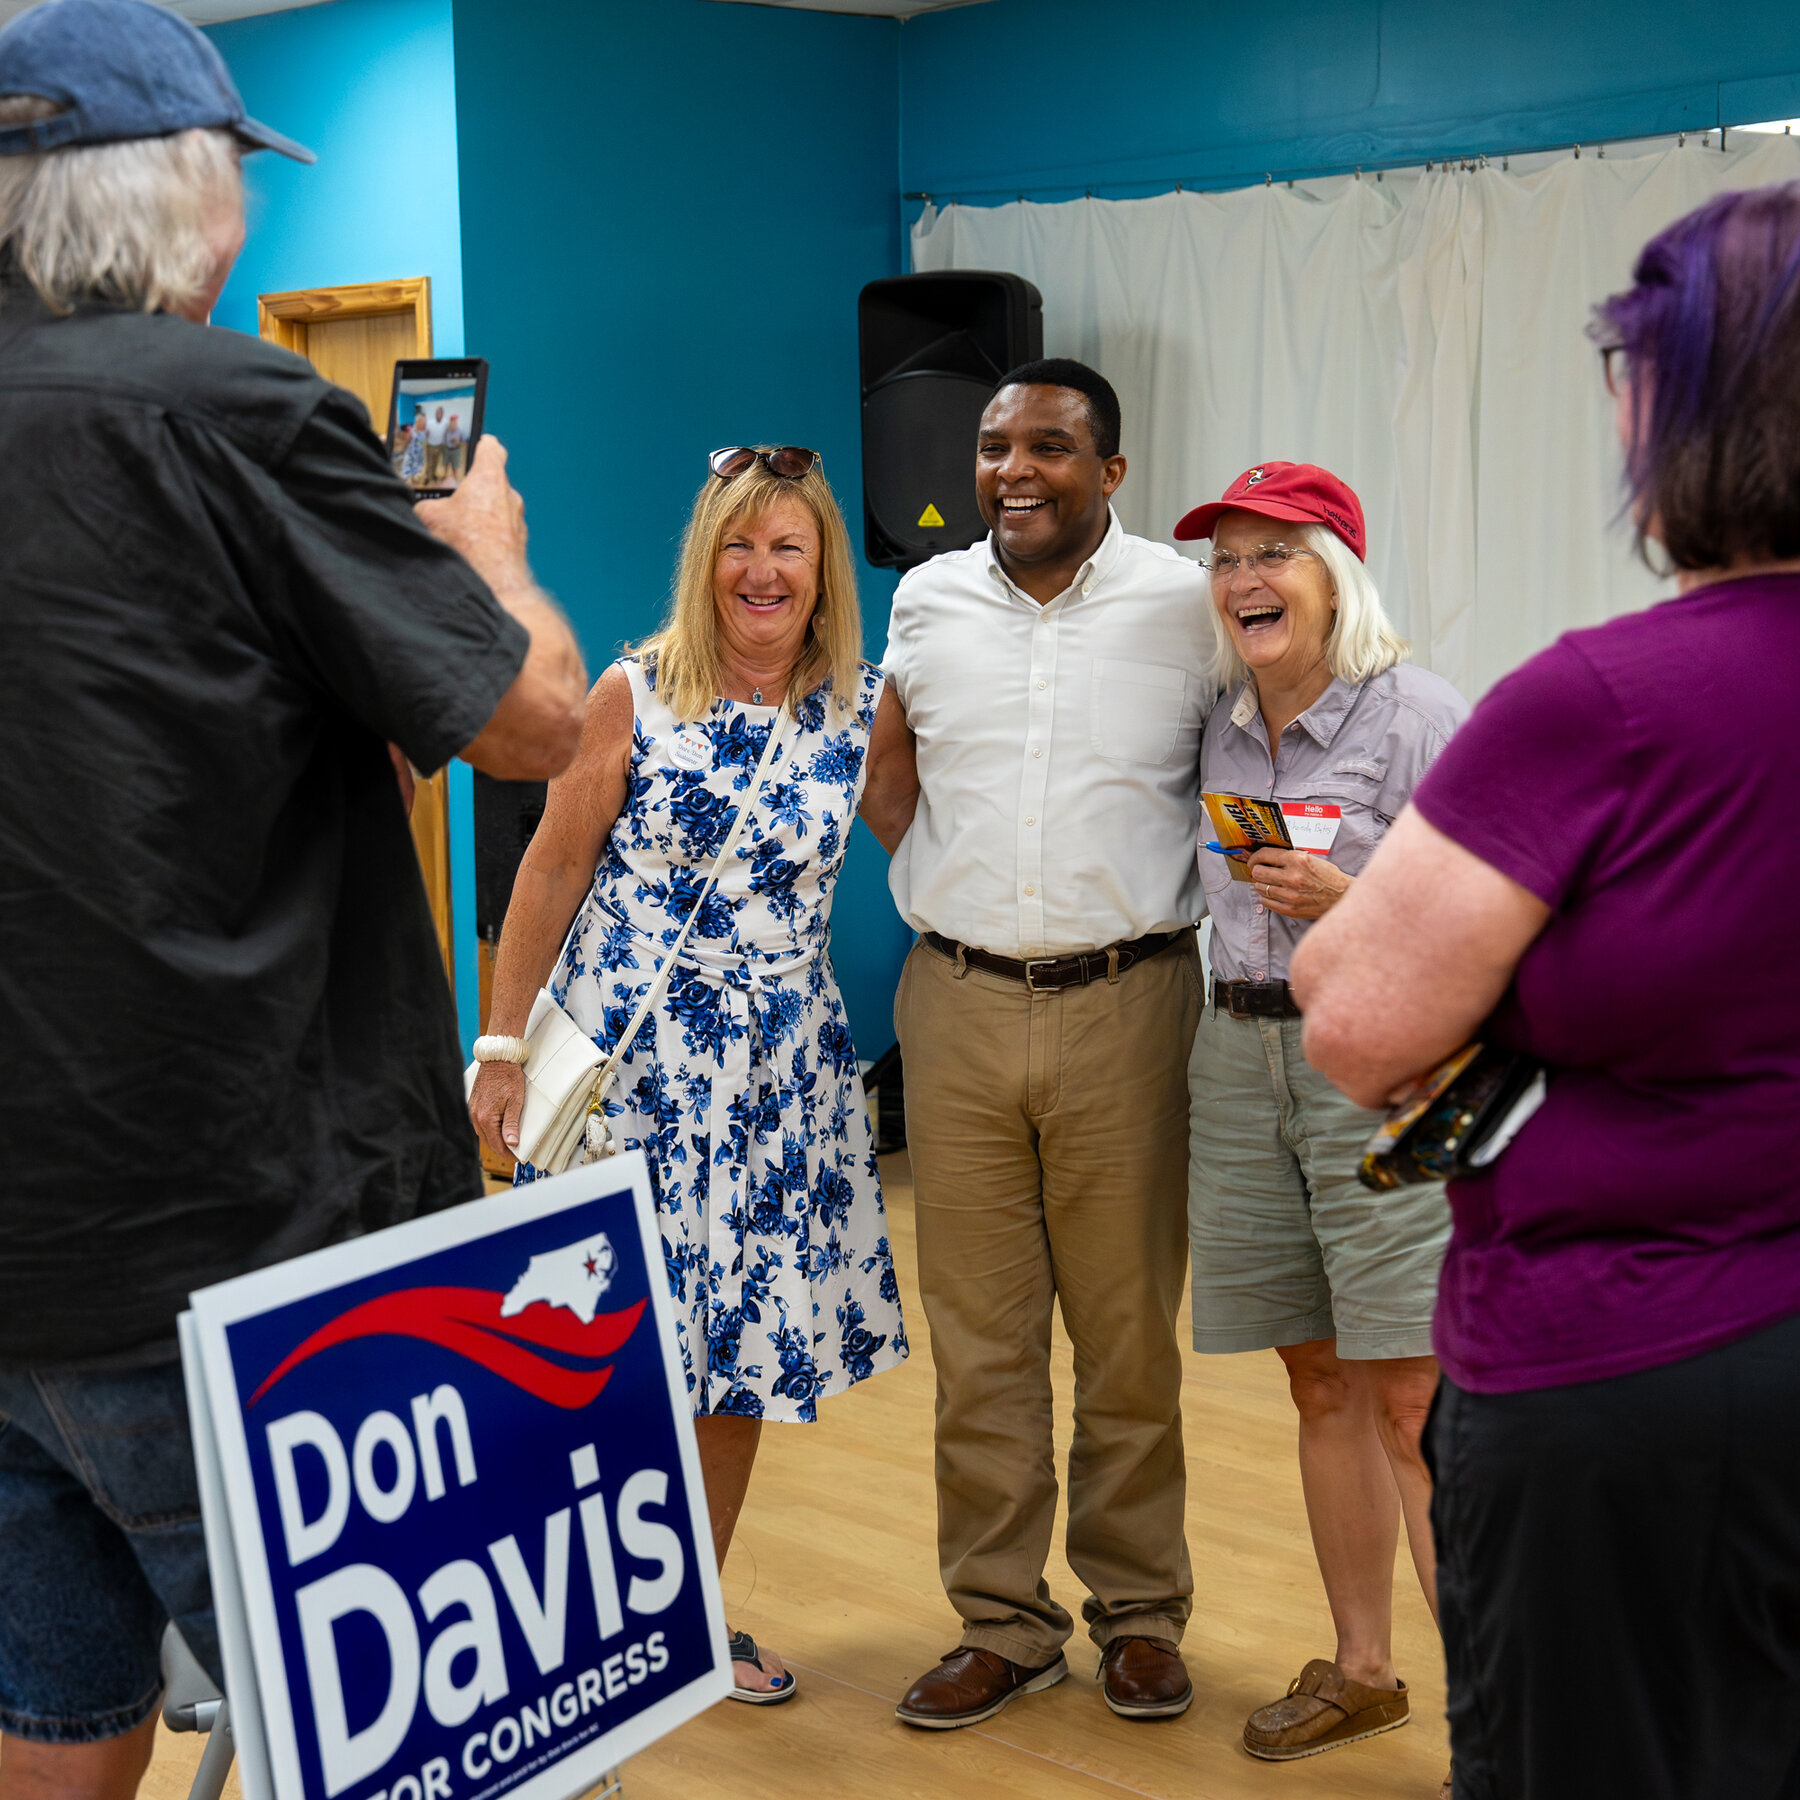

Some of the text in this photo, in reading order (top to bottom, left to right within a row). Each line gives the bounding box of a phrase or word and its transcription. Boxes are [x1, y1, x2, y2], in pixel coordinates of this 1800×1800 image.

[1323, 504, 1357, 539] hatteras
[1305, 804, 1323, 813] Hello
[266, 1384, 478, 1566] Don
[296, 1443, 685, 1799] Davis
[462, 1631, 670, 1779] CONGRESS
